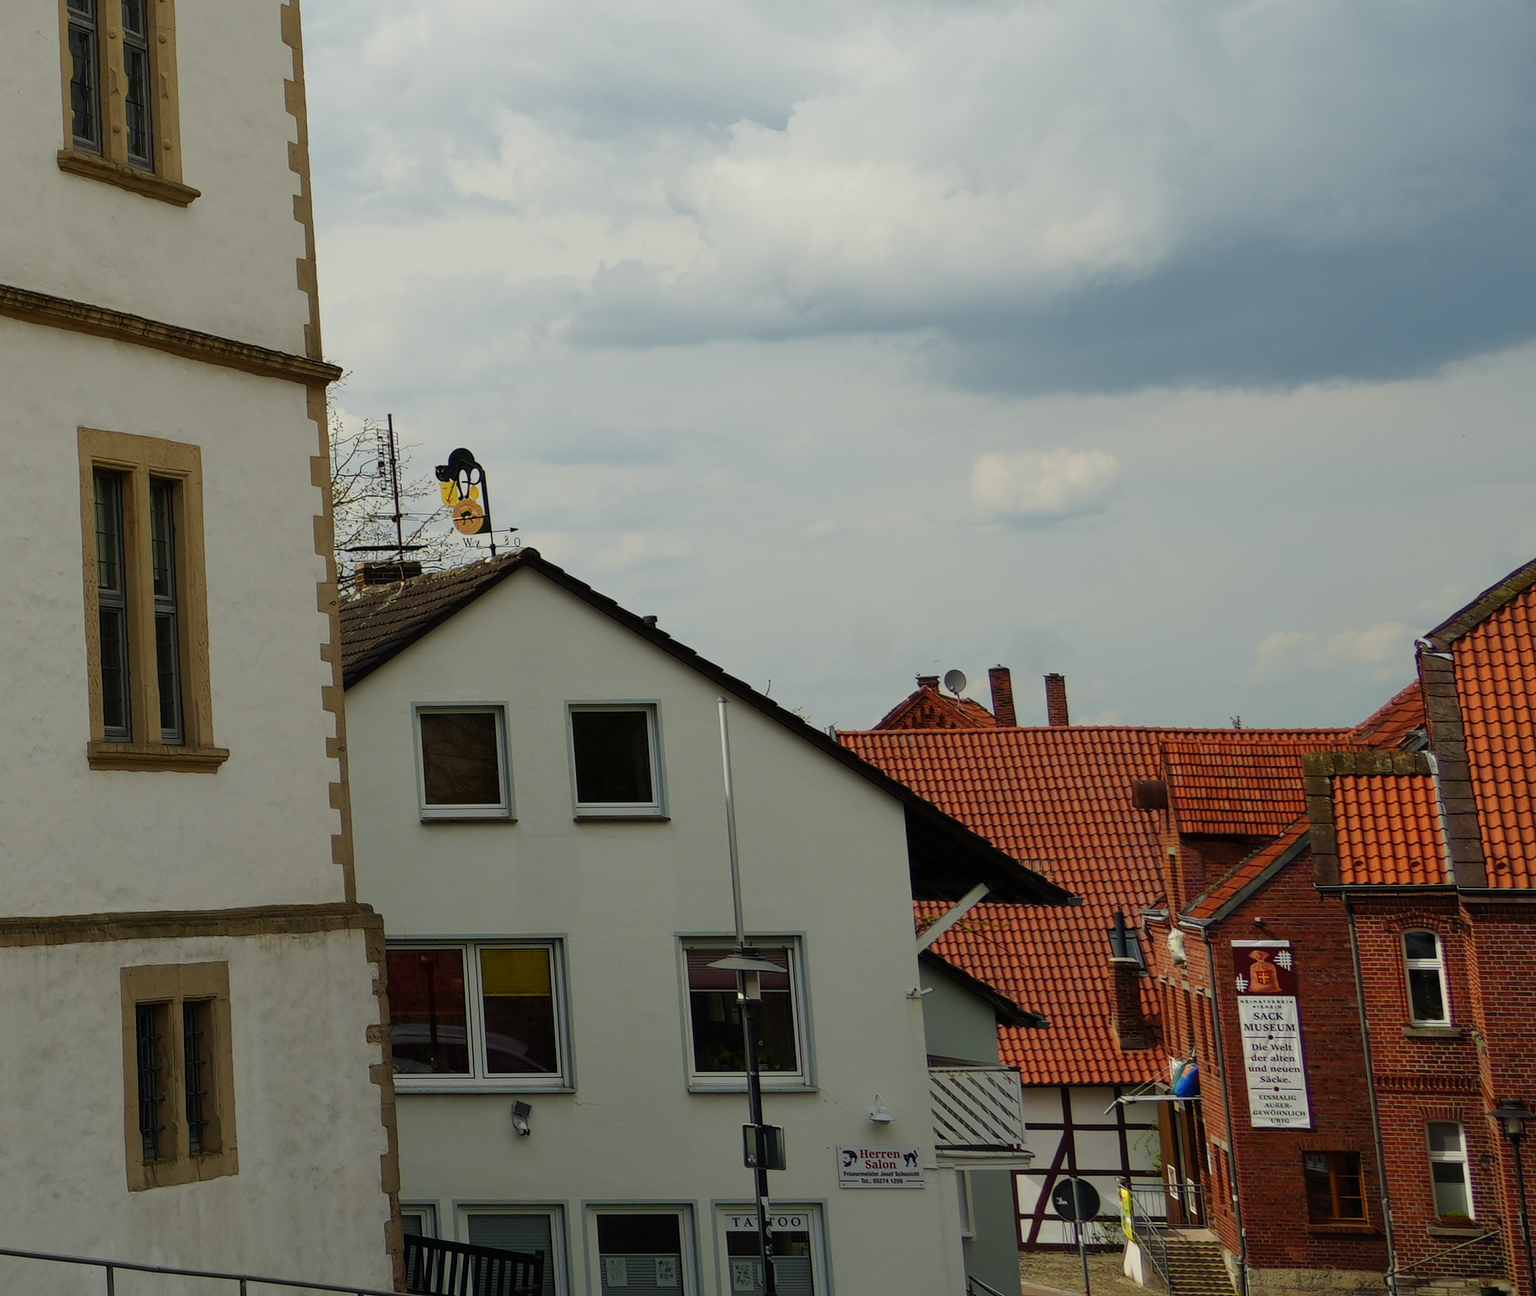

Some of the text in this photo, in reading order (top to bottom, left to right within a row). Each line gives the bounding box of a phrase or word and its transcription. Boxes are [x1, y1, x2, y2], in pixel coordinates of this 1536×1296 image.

[1253, 1012, 1284, 1020] SACK
[1251, 1043, 1293, 1051] Die Welt
[1251, 1054, 1295, 1062] der alten
[1260, 1075, 1291, 1083] Säcke.
[859, 1149, 901, 1159] Herren
[865, 1159, 897, 1169] Salon
[732, 1217, 801, 1227] TATOO
